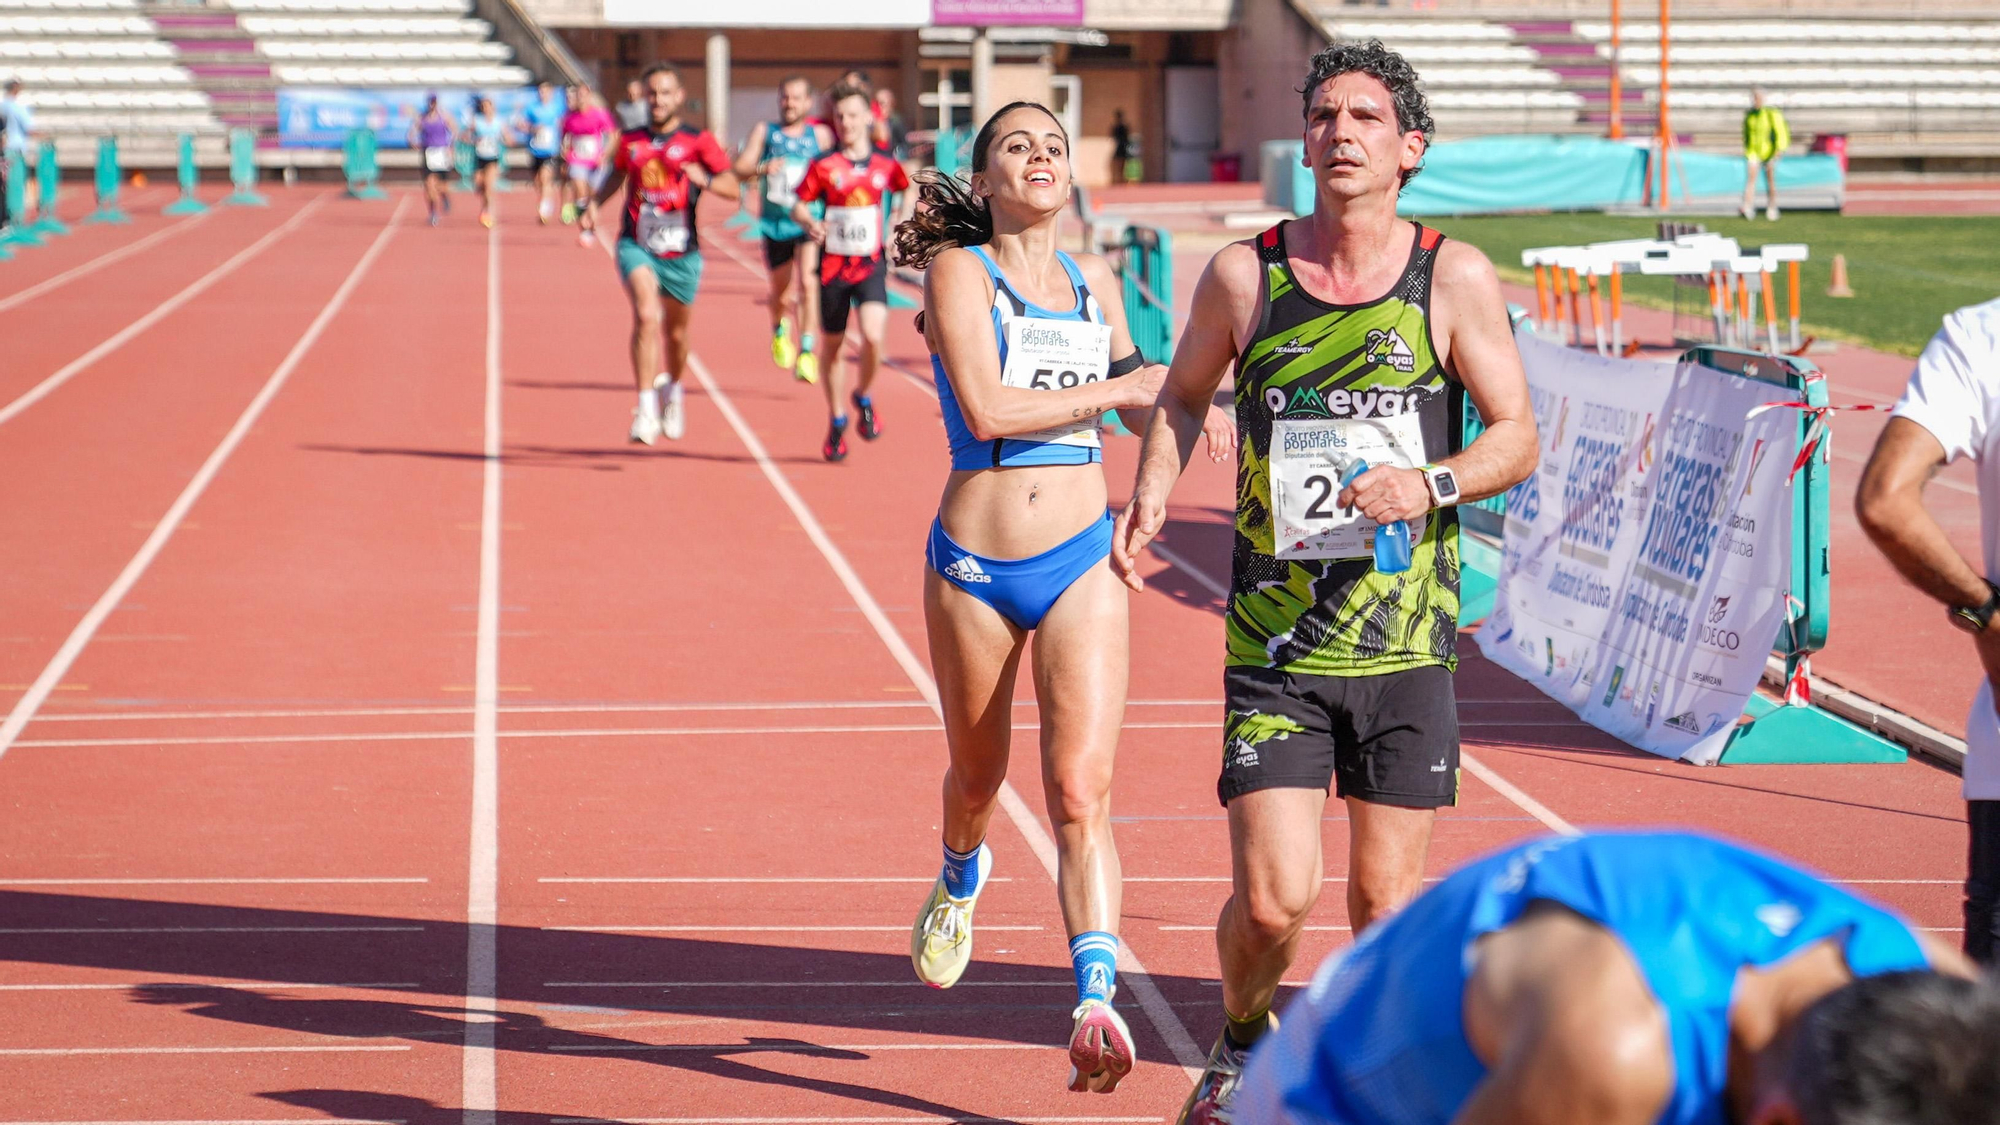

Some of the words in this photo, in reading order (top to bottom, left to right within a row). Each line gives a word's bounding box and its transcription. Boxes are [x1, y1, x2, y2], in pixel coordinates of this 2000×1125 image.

[1021, 327, 1062, 339] carreras
[1021, 334, 1070, 347] populares
[1284, 429, 1337, 441] carreras
[1284, 436, 1347, 452] populares
[944, 566, 992, 583] adidas
[1691, 671, 1723, 687] ORGANIZAN
